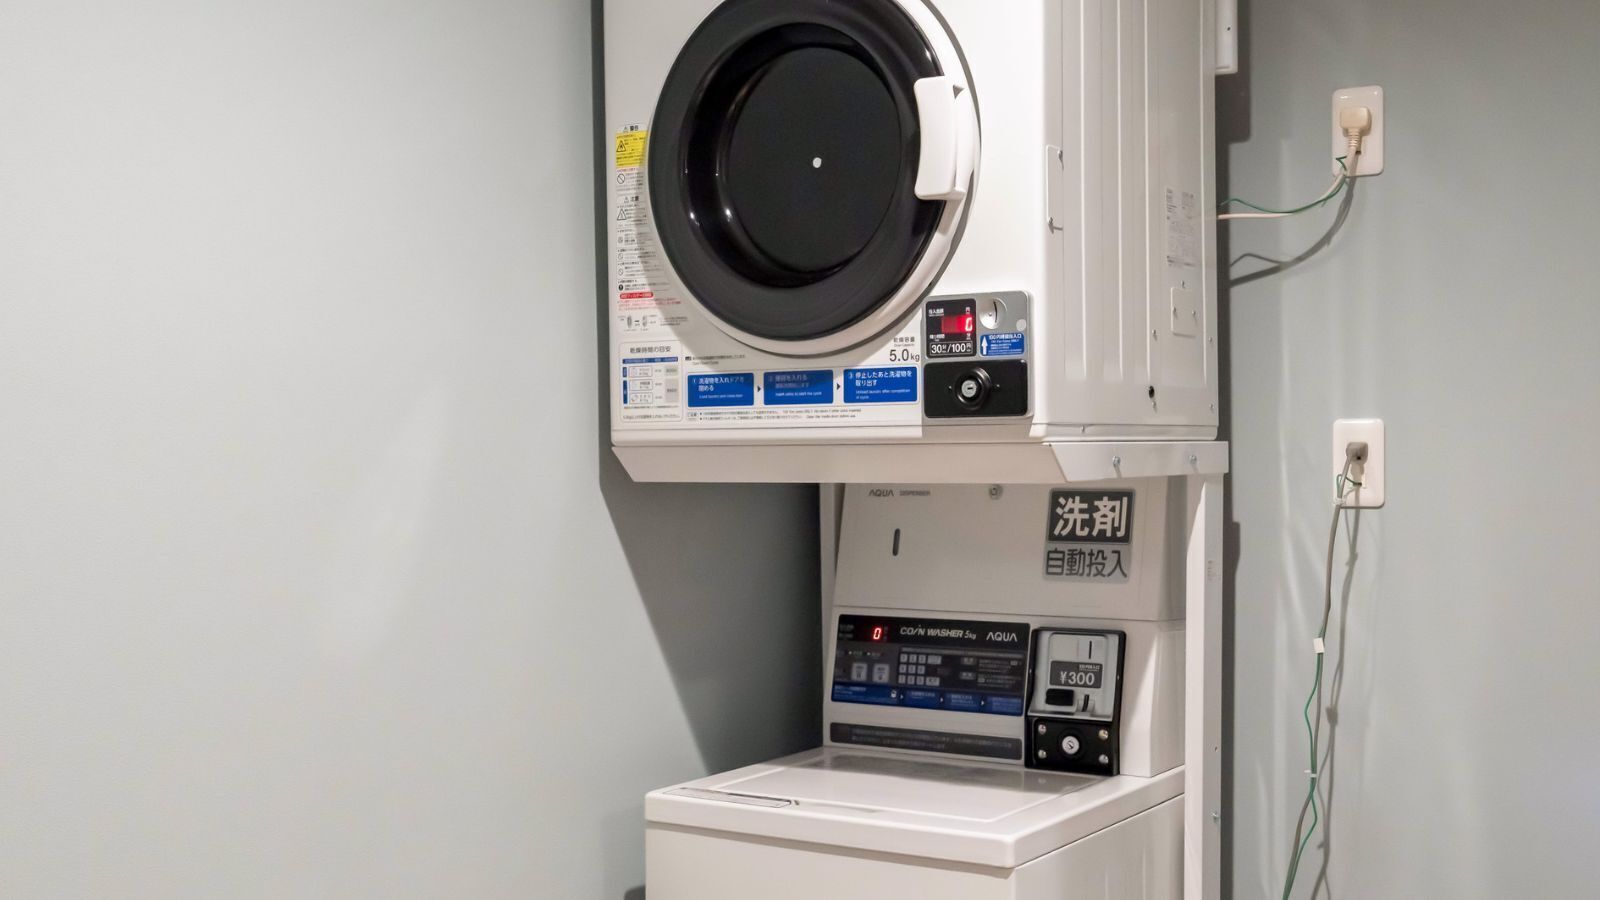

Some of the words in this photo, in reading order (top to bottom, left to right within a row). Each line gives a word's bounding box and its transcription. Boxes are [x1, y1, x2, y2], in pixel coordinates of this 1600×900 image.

[965, 317, 973, 332] 0
[855, 370, 912, 379] 停止したあと洗濯物を
[855, 379, 877, 387] 取り出す
[868, 489, 894, 497] AQUA
[1053, 496, 1128, 538] 洗剤
[1045, 547, 1128, 578] 自動投入
[873, 627, 881, 640] 0
[927, 628, 964, 638] WASHER
[986, 631, 1018, 642] AQUA
[1060, 671, 1095, 686] ¥300
